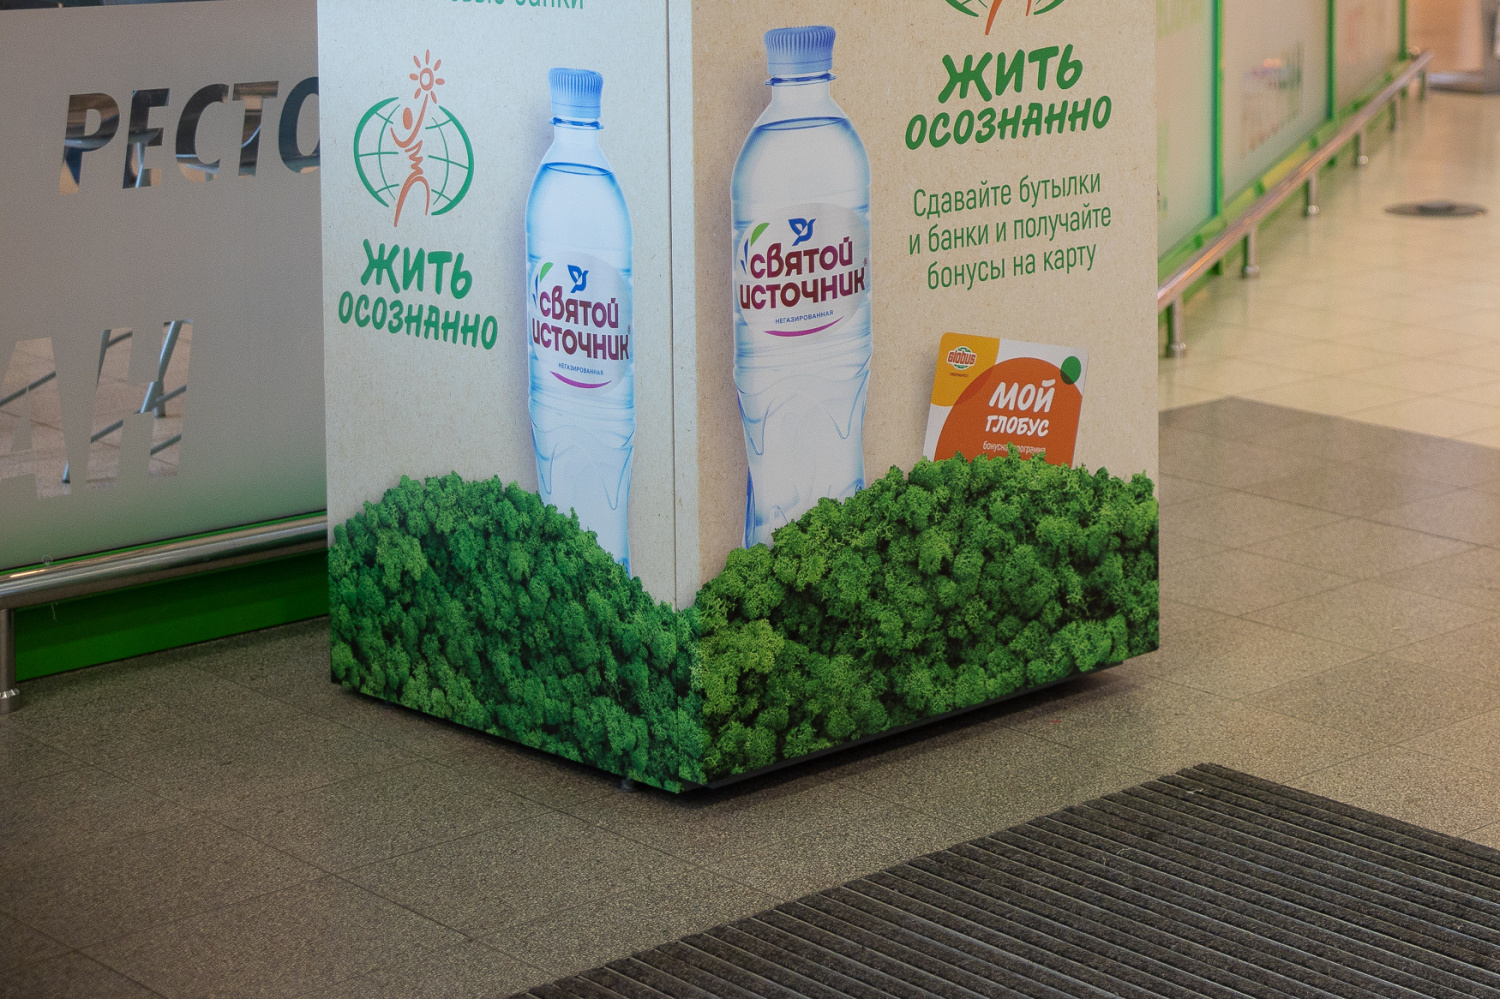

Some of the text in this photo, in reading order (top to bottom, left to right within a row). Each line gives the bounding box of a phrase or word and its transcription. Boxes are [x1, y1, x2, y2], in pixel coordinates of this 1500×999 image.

[937, 43, 1083, 104] ЖИТЬ
[905, 95, 1112, 150] ОСОЗНАННО
[913, 172, 1101, 220] Сдавайте бутылки
[909, 202, 1112, 255] и банки и получайте
[360, 238, 472, 300] ЖИТЬ
[927, 243, 1097, 291] бонусы на карту
[338, 291, 498, 351] ОСОЗНАННО
[775, 309, 834, 324] НЕГАЗИРОВАННАЯ
[558, 362, 604, 376] НЕГАЗИРОВАННАЯ
[988, 378, 1056, 413] МОЙ
[985, 415, 1050, 437] ГЛОБУС
[1016, 445, 1047, 455] рограмма
